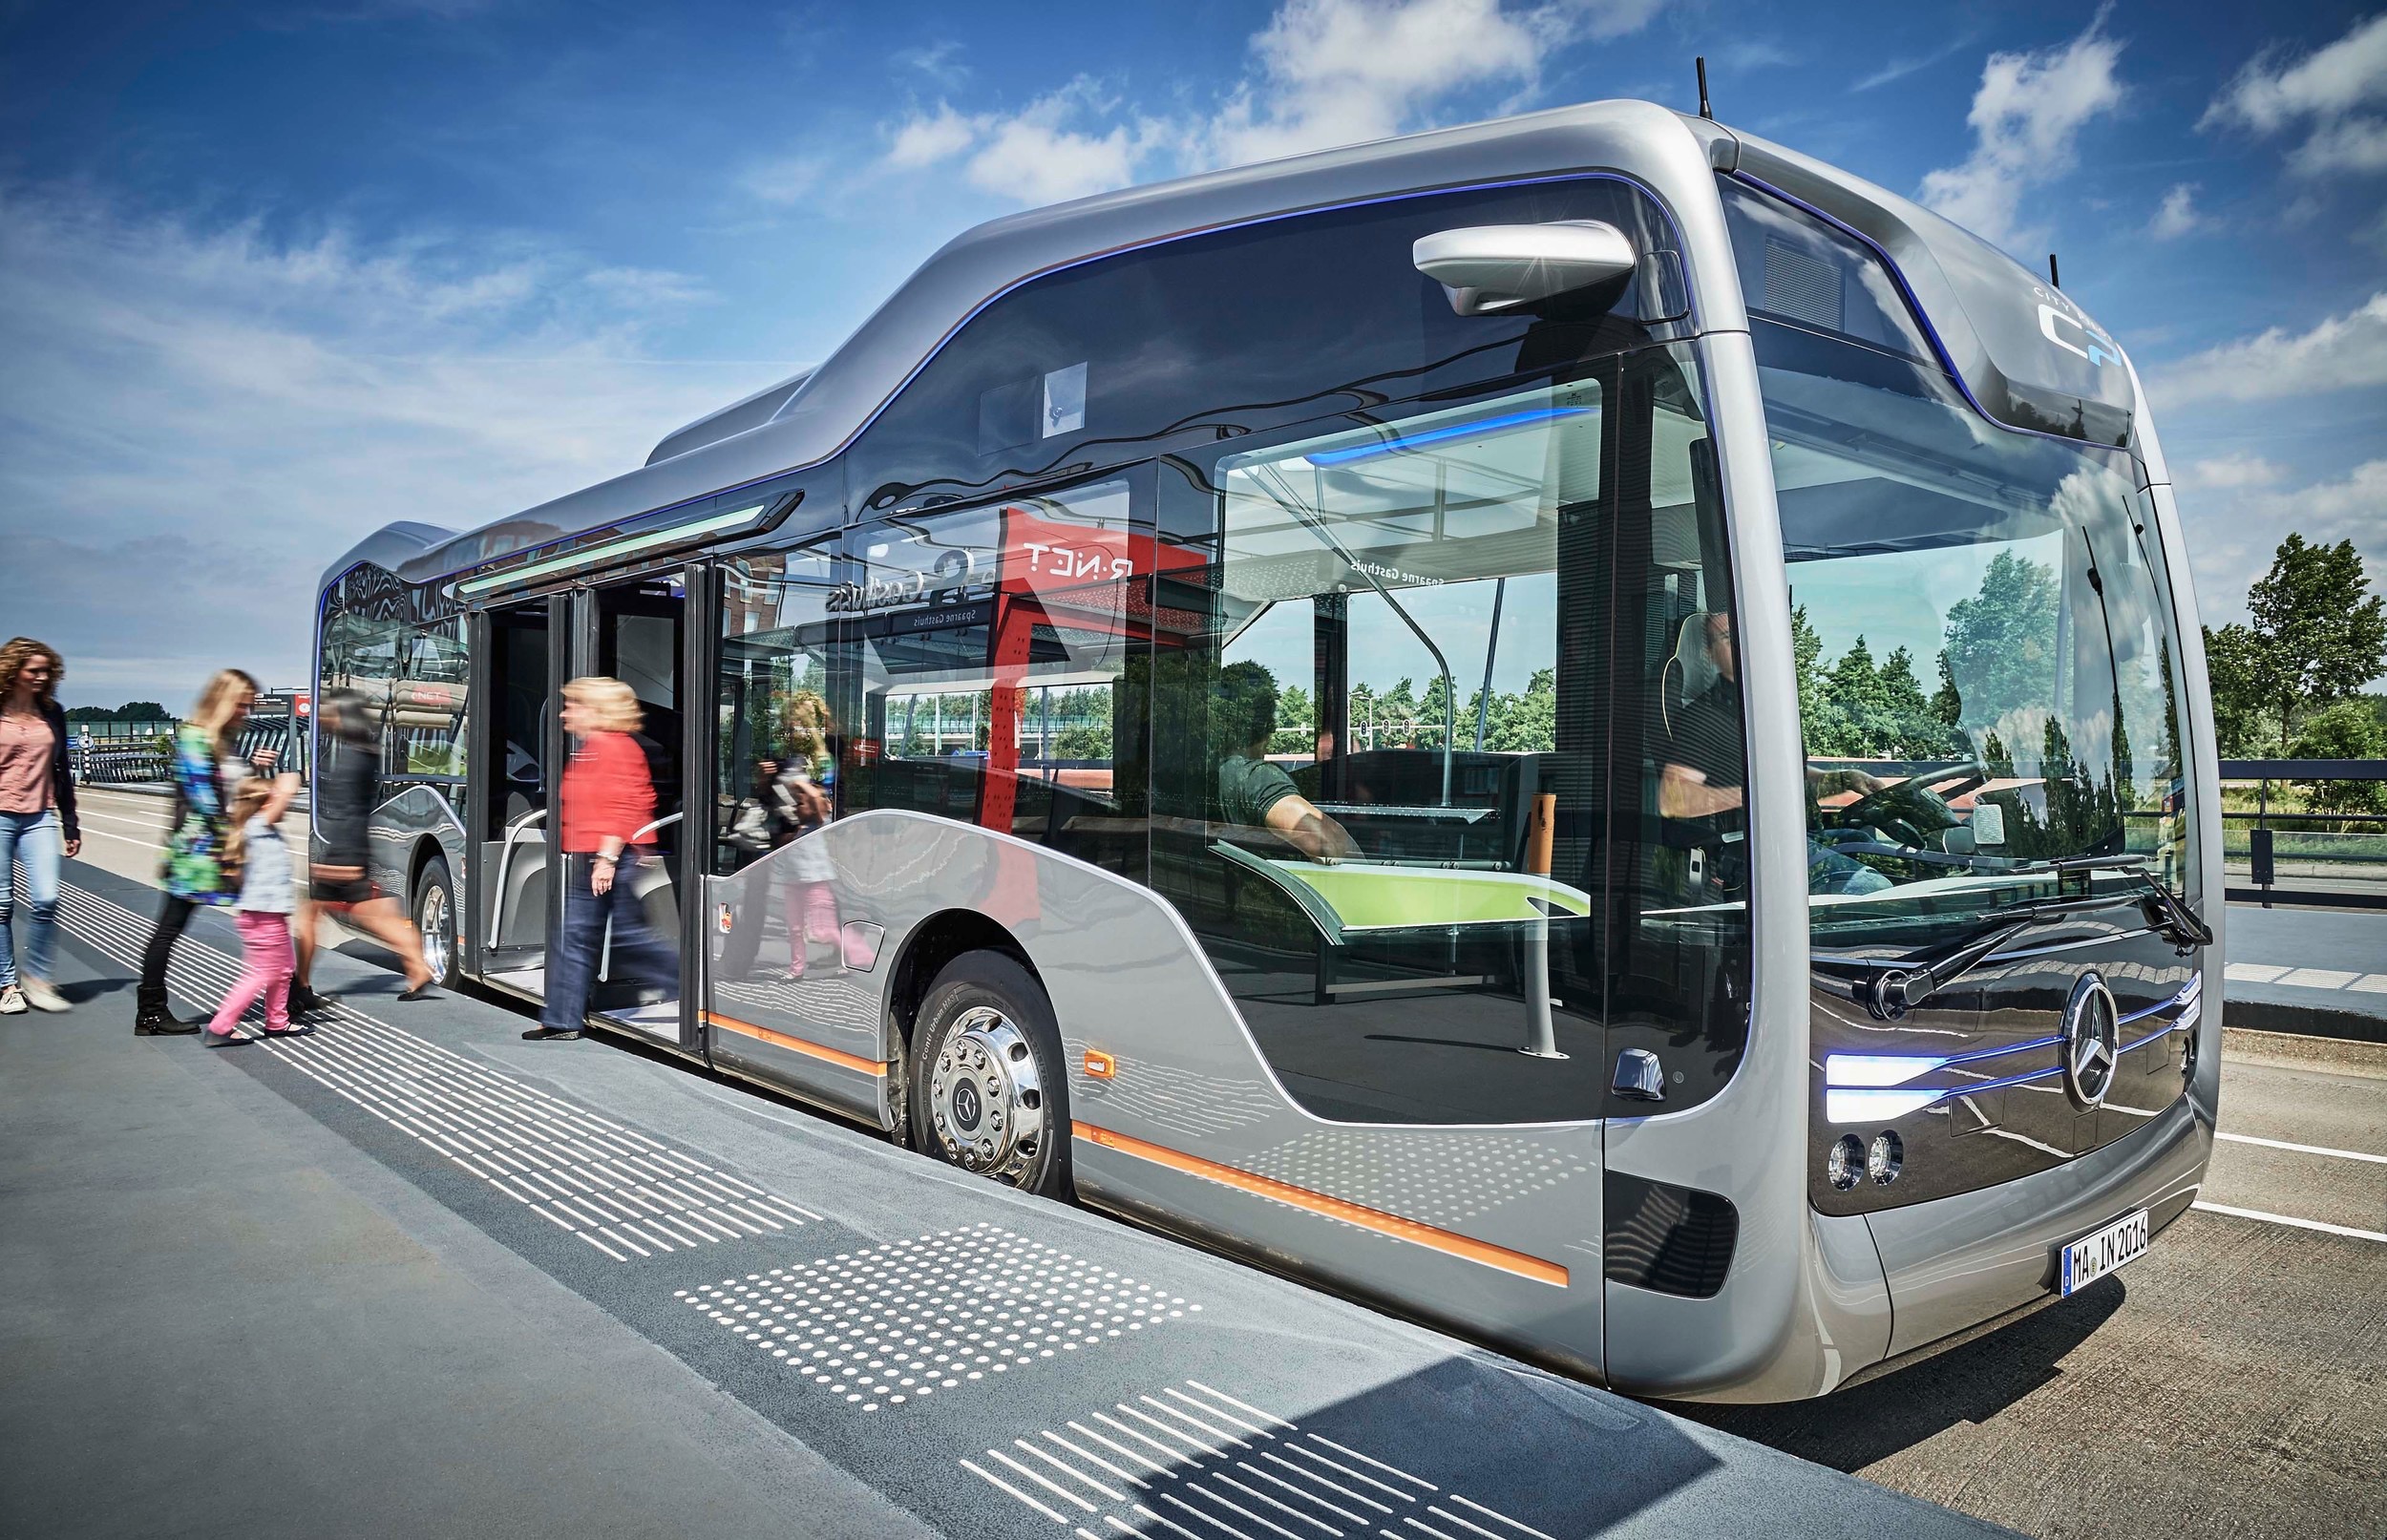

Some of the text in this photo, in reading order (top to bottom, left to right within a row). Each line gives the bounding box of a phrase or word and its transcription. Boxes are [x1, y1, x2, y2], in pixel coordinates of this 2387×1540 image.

[2034, 286, 2069, 312] CITY
[921, 1032, 933, 1061] Conti
[2073, 1214, 2146, 1286] MA IN 2016
